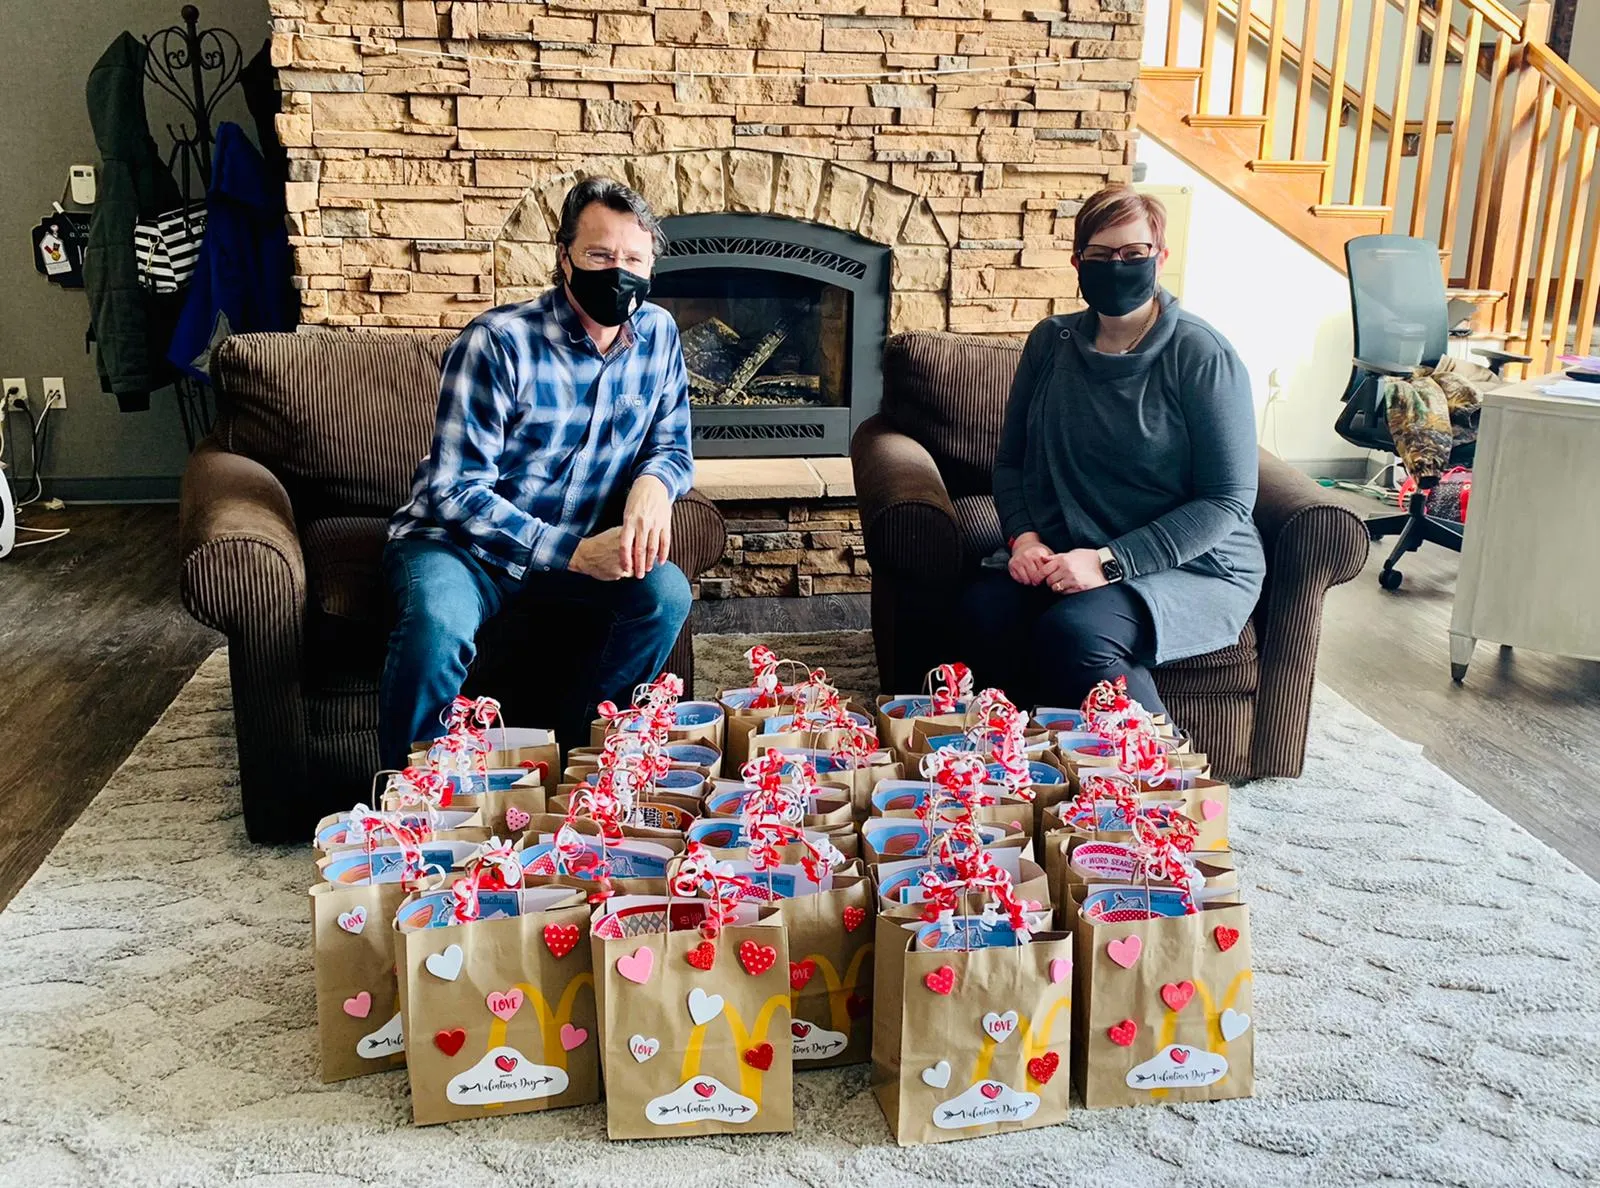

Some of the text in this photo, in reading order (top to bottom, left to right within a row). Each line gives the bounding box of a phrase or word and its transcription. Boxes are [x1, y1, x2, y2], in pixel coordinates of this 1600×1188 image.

[1088, 857, 1109, 865] WORD
[343, 913, 364, 930] LOVE
[792, 968, 809, 980] OVE
[493, 997, 517, 1012] LOVE
[989, 1020, 1012, 1033] LOVE
[633, 1043, 654, 1056] LOVE
[812, 1042, 828, 1055] Day
[1191, 1069, 1206, 1082] Day
[520, 1077, 538, 1091] Day
[718, 1103, 735, 1117] Day
[1002, 1104, 1019, 1117] Day
